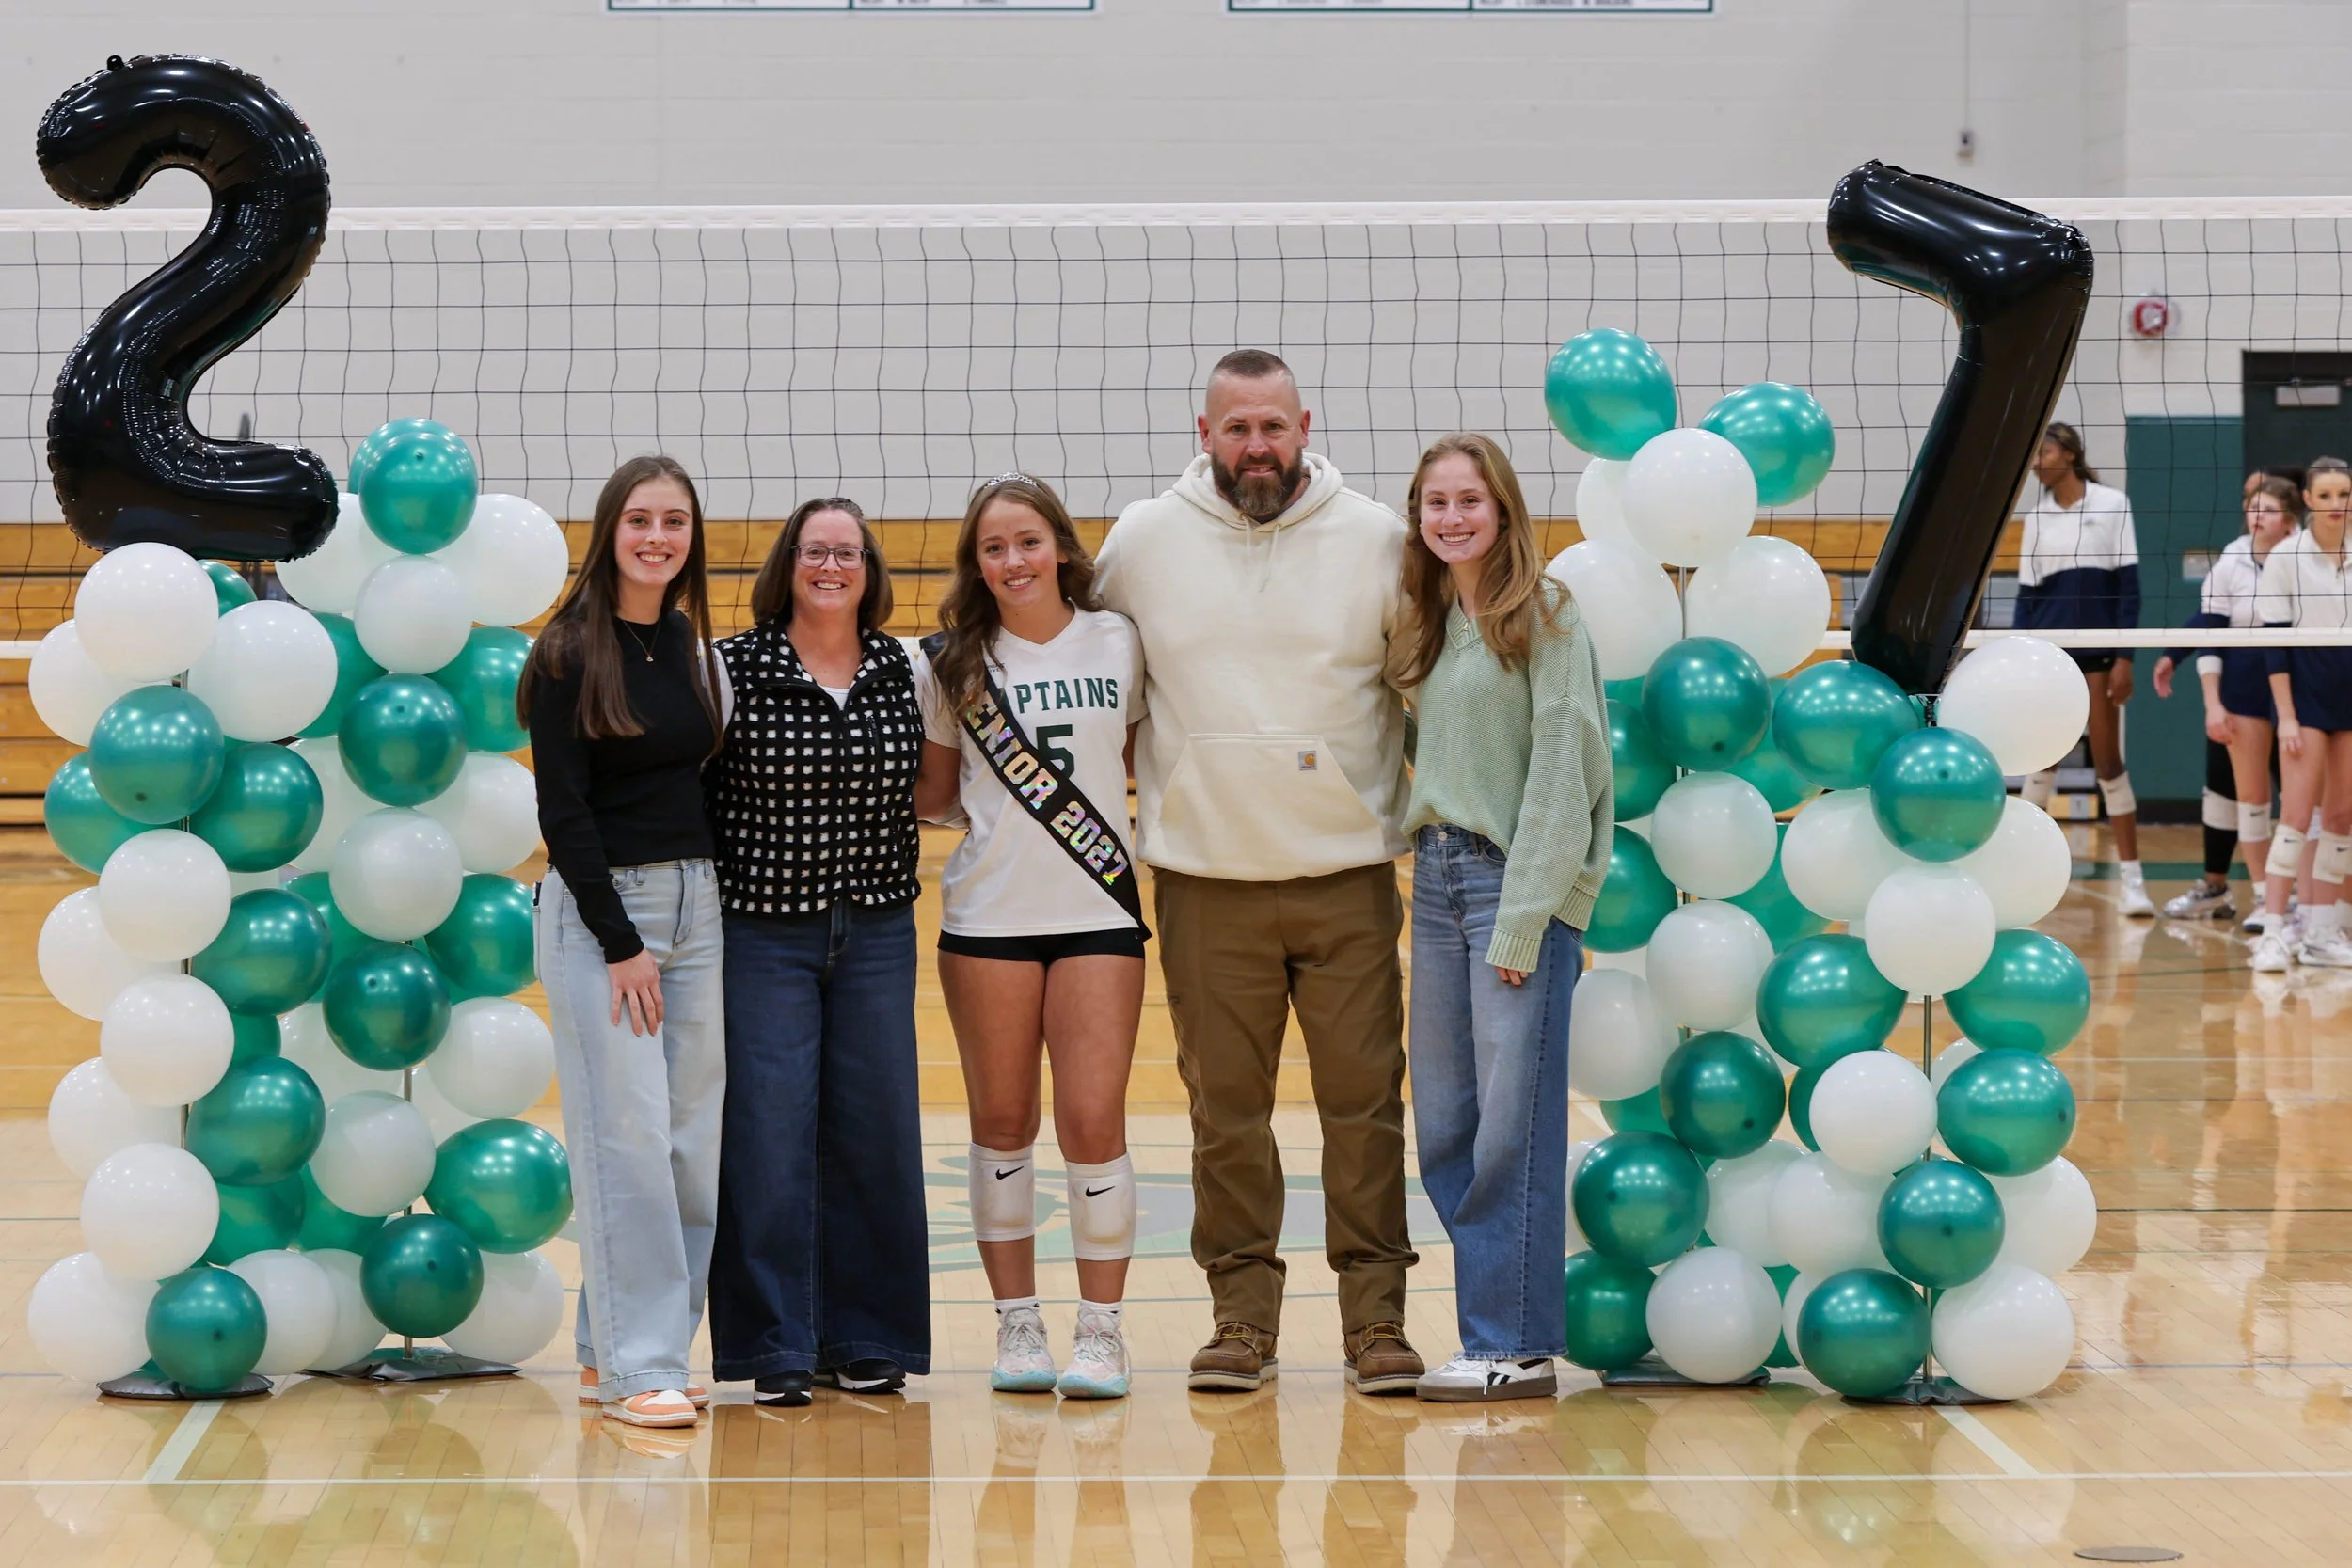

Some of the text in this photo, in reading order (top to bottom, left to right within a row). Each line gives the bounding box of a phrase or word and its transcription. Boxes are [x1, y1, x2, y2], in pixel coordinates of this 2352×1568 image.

[36, 54, 340, 563] 2
[1826, 159, 2093, 698] 7
[966, 690, 1058, 810] ENIOR
[1013, 677, 1118, 714] PTAINS
[1036, 723, 1075, 780] 5
